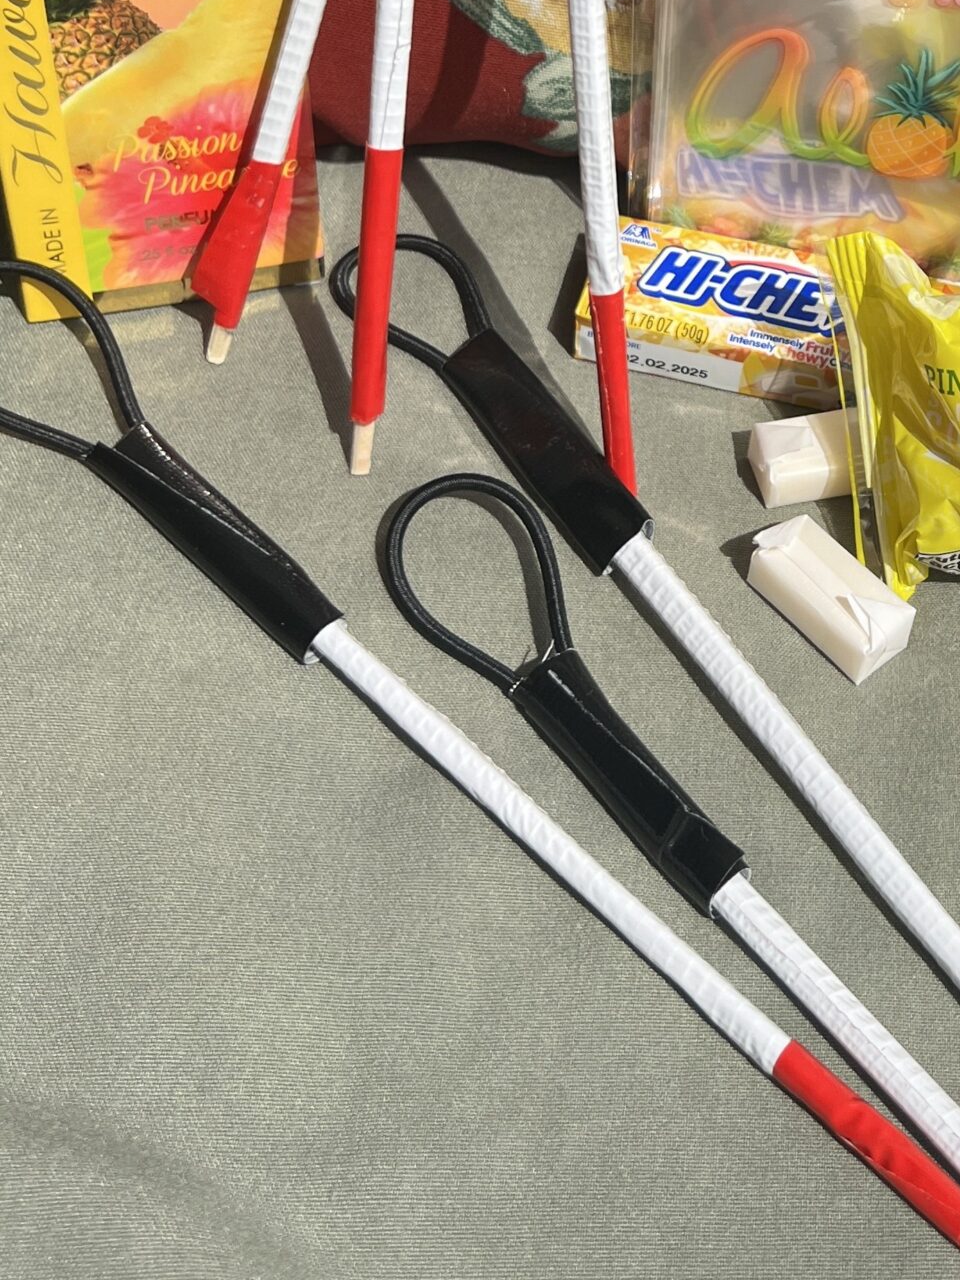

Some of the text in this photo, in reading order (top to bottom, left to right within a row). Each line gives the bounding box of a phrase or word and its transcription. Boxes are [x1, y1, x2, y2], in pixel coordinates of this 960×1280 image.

[107, 129, 243, 173] Passion
[138, 157, 300, 205] Pineae
[40, 208, 60, 226] IN
[620, 236, 657, 247] ORINAGA
[629, 311, 710, 345] 1.76 OZ (50g)
[729, 334, 775, 352] Intensely
[749, 329, 805, 350] Immensely
